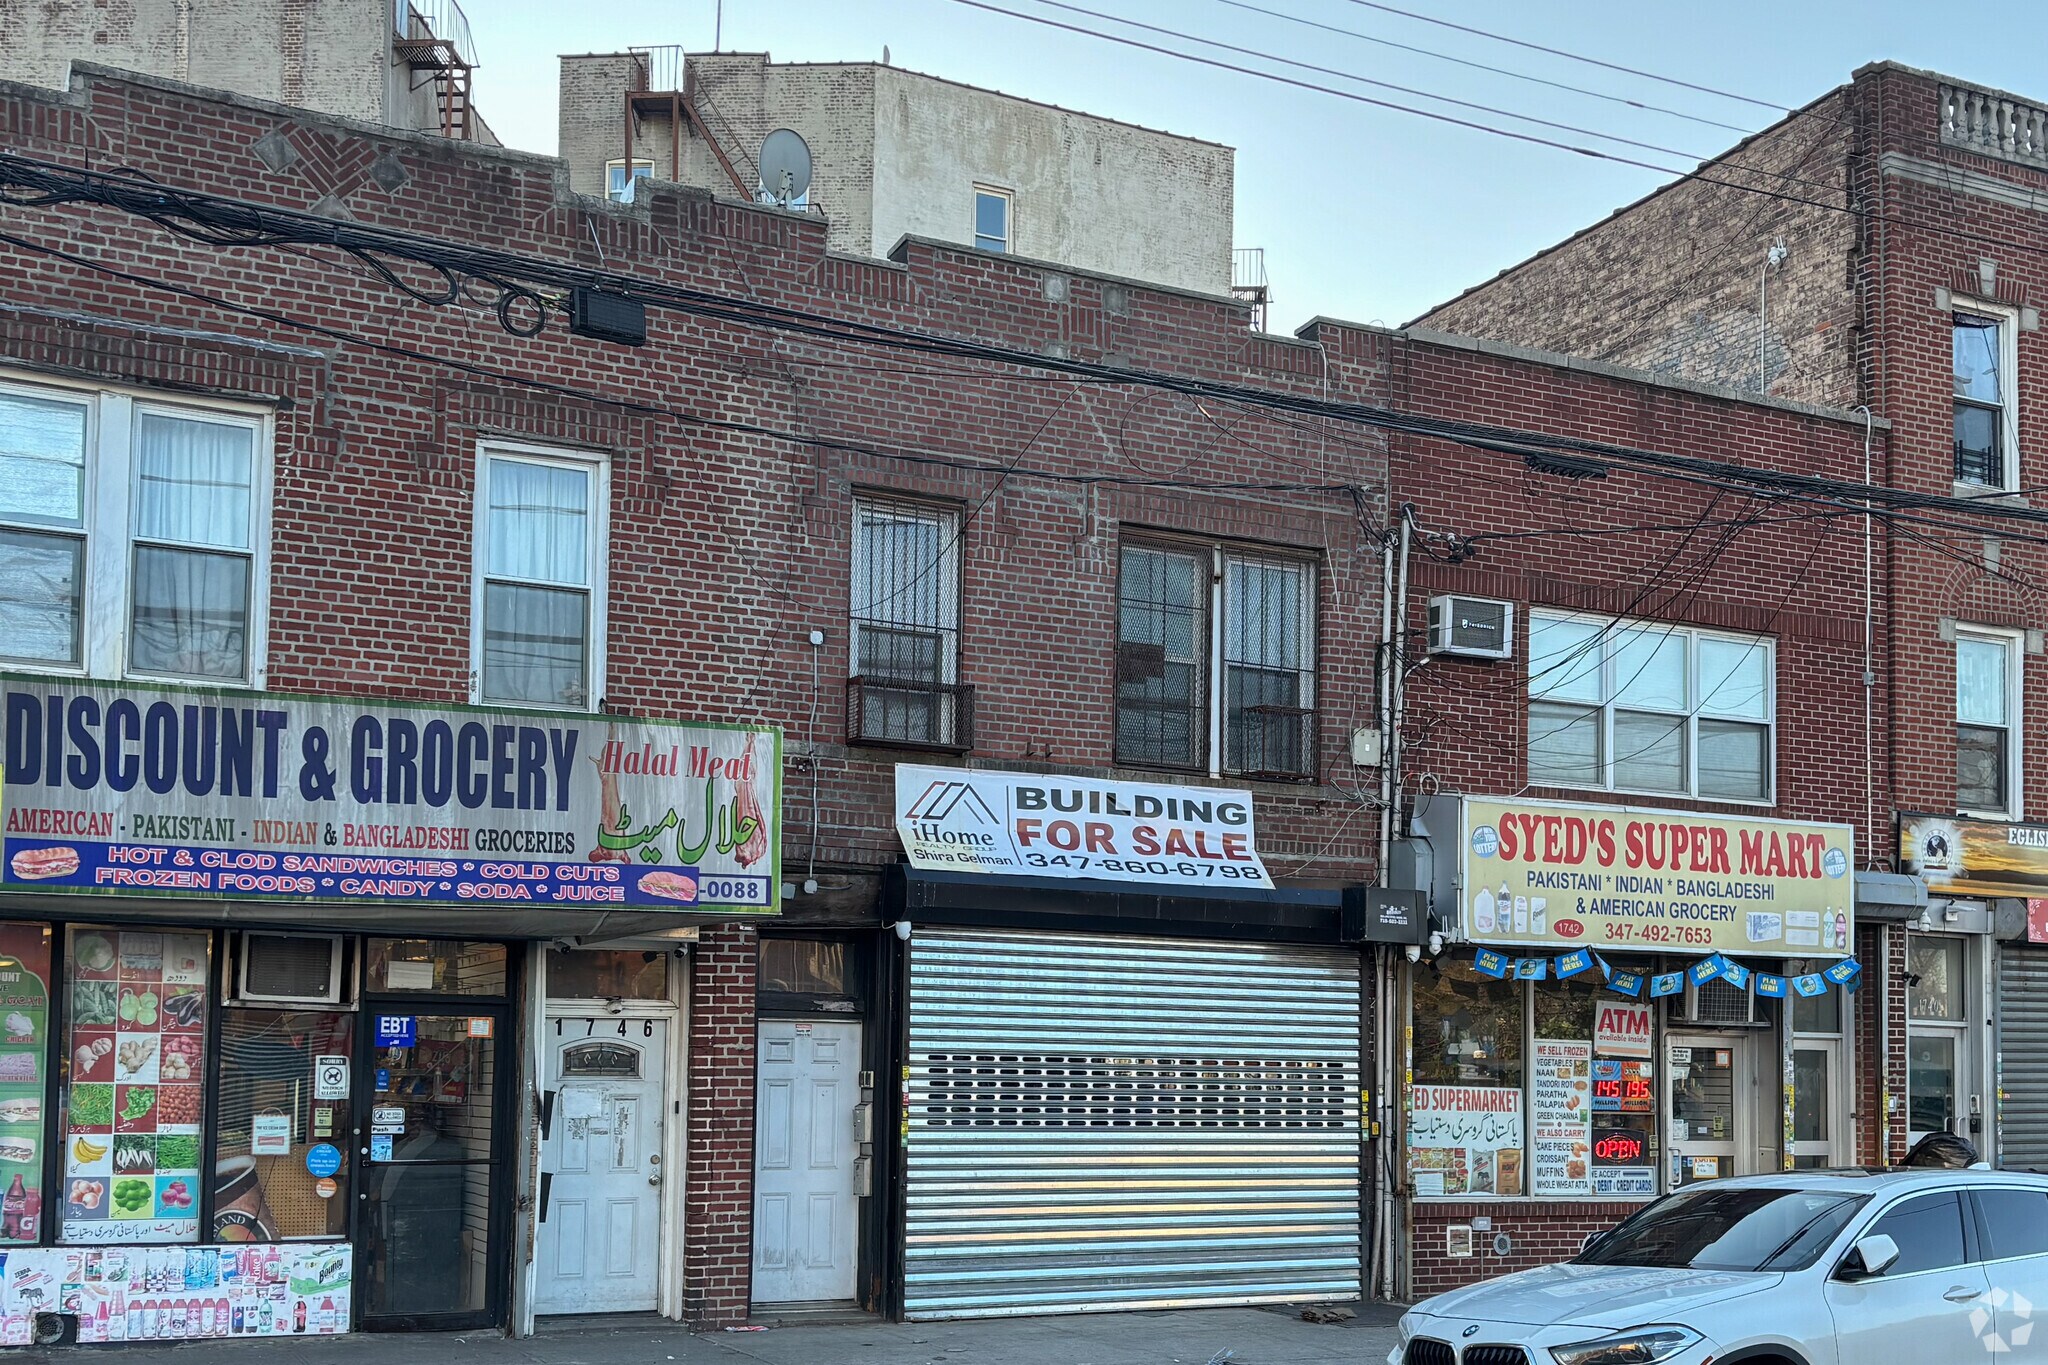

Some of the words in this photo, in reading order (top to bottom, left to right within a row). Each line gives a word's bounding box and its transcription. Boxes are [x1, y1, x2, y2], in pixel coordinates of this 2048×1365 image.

[5, 692, 288, 798] DISCOUNT
[300, 726, 337, 802] &
[350, 714, 579, 812] GROCERY
[602, 740, 679, 777] Halal
[685, 745, 752, 782] Meat
[1016, 786, 1248, 825] BUILDING
[677, 777, 759, 865] حلال
[6, 807, 114, 836] AMERICAN
[132, 814, 235, 842] PAKISTANI
[253, 820, 318, 846] INDIAN
[324, 822, 338, 846] &
[343, 823, 470, 851] BANGLADESHI
[475, 828, 575, 855] GROCERIES
[912, 819, 995, 846] iHome
[2007, 827, 2048, 847] EGLIS
[916, 841, 955, 850] REALTY
[1016, 818, 1118, 855] FOR
[1132, 825, 1253, 862] SALE
[1472, 842, 1498, 854] LOTTERY
[1498, 812, 1616, 868] SYED'S
[1625, 820, 1731, 875] SUPER
[1739, 829, 1826, 880] MART
[108, 845, 168, 865] HOT
[173, 849, 195, 867] &
[200, 851, 277, 871] CLOD
[283, 854, 458, 878] SANDWICHES
[480, 862, 550, 880] COLD
[555, 865, 621, 882] CUTS
[913, 849, 955, 862] Shira
[957, 852, 1013, 866] Gelman
[1026, 853, 1263, 880] 347-860-6798
[95, 866, 212, 889] FROZEN
[218, 873, 316, 894] FOODS
[339, 878, 436, 897] CANDY
[456, 882, 532, 900] SODA
[552, 885, 625, 901] JUICE
[1527, 871, 1602, 891] PAKISTANI
[1615, 876, 1663, 894] INDIAN
[1676, 879, 1775, 900] BANGLADESHI
[1576, 897, 1586, 914] &
[1590, 898, 1665, 917] AMERICAN
[1669, 902, 1737, 921] GROCERY
[1558, 923, 1580, 934] 1742
[1605, 922, 1712, 944] 347-492-7653
[1483, 953, 1499, 963] PLAY
[1562, 954, 1579, 965] PLAY
[1696, 960, 1713, 972] PLAY
[1832, 964, 1847, 975] PLAY
[1762, 977, 1777, 985] PLAY
[380, 1016, 410, 1033] EBT
[1597, 1008, 1650, 1035] ATM
[1537, 1046, 1547, 1055] WE
[1548, 1046, 1563, 1056] SELL
[1563, 1047, 1588, 1056] FROZEN
[1536, 1058, 1573, 1067] VEGETABLES
[1536, 1069, 1555, 1077] NAAN
[1536, 1080, 1560, 1088] TANDORI
[1596, 1080, 1620, 1098] 145
[1626, 1080, 1650, 1098] 195
[1412, 1087, 1430, 1111] ED
[1432, 1088, 1519, 1113] SUPERMARKET
[1536, 1090, 1568, 1099] PARATHA
[1537, 1101, 1566, 1109] TALAPIA
[1536, 1111, 1554, 1120] GREEN
[1555, 1112, 1579, 1120] CHANNA
[1413, 1117, 1451, 1140] دستیاب
[1451, 1113, 1490, 1145] گروسری
[1485, 1113, 1518, 1147] پاکستانی
[1537, 1129, 1545, 1137] WE
[1546, 1129, 1563, 1137] ALSO
[1564, 1129, 1586, 1137] CARRY
[1536, 1142, 1552, 1151] CAKE
[1553, 1142, 1574, 1151] PIECES
[1595, 1140, 1642, 1158] OPEN
[1536, 1155, 1570, 1163] CROISSANT
[1536, 1167, 1565, 1177] MUFFINS
[1599, 1170, 1621, 1178] ACCEPT
[1537, 1180, 1556, 1189] WHOLE
[1556, 1181, 1574, 1189] WHEAT
[1575, 1181, 1589, 1190] ATTA
[1597, 1179, 1612, 1191] DEBIT
[1616, 1180, 1635, 1191] CREDIT
[1635, 1180, 1653, 1191] CARDS
[175, 1219, 197, 1236] حلال
[14, 1267, 31, 1278] ZEBRA
